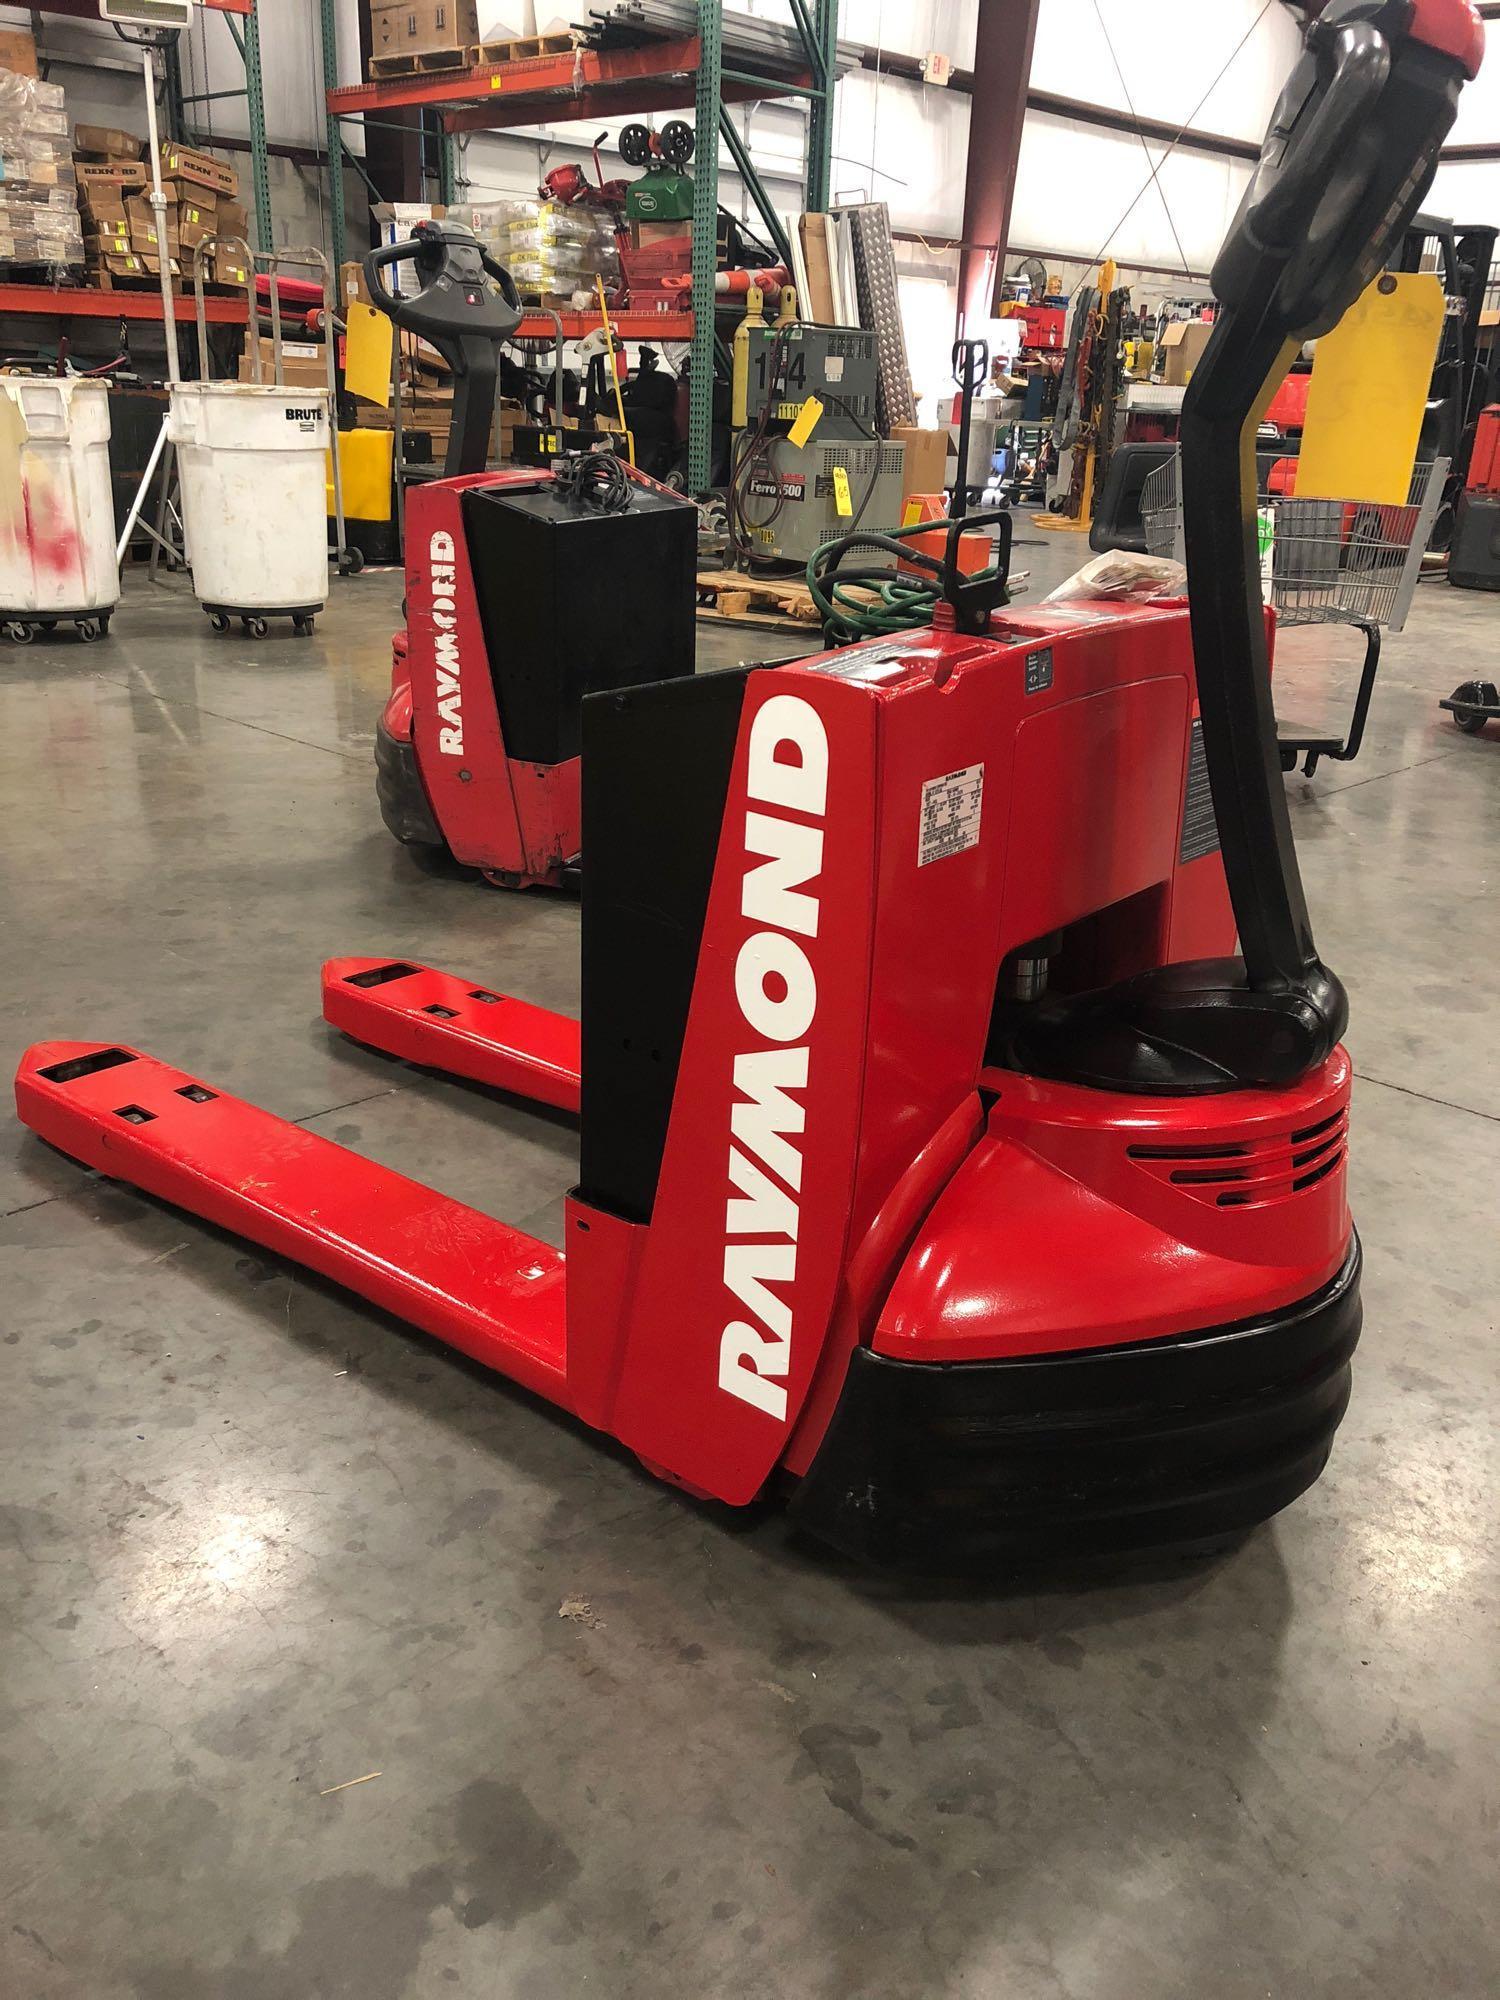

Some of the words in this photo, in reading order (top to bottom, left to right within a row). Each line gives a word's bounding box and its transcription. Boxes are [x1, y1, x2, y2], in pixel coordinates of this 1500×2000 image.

[84, 167, 137, 176] REXNRD
[183, 160, 233, 184] REXNRD
[285, 408, 322, 420] BRUTE
[750, 479, 776, 495] Ferro
[778, 483, 802, 497] 500
[430, 531, 464, 756] RAYMOND
[718, 695, 829, 1422] RAYMOND
